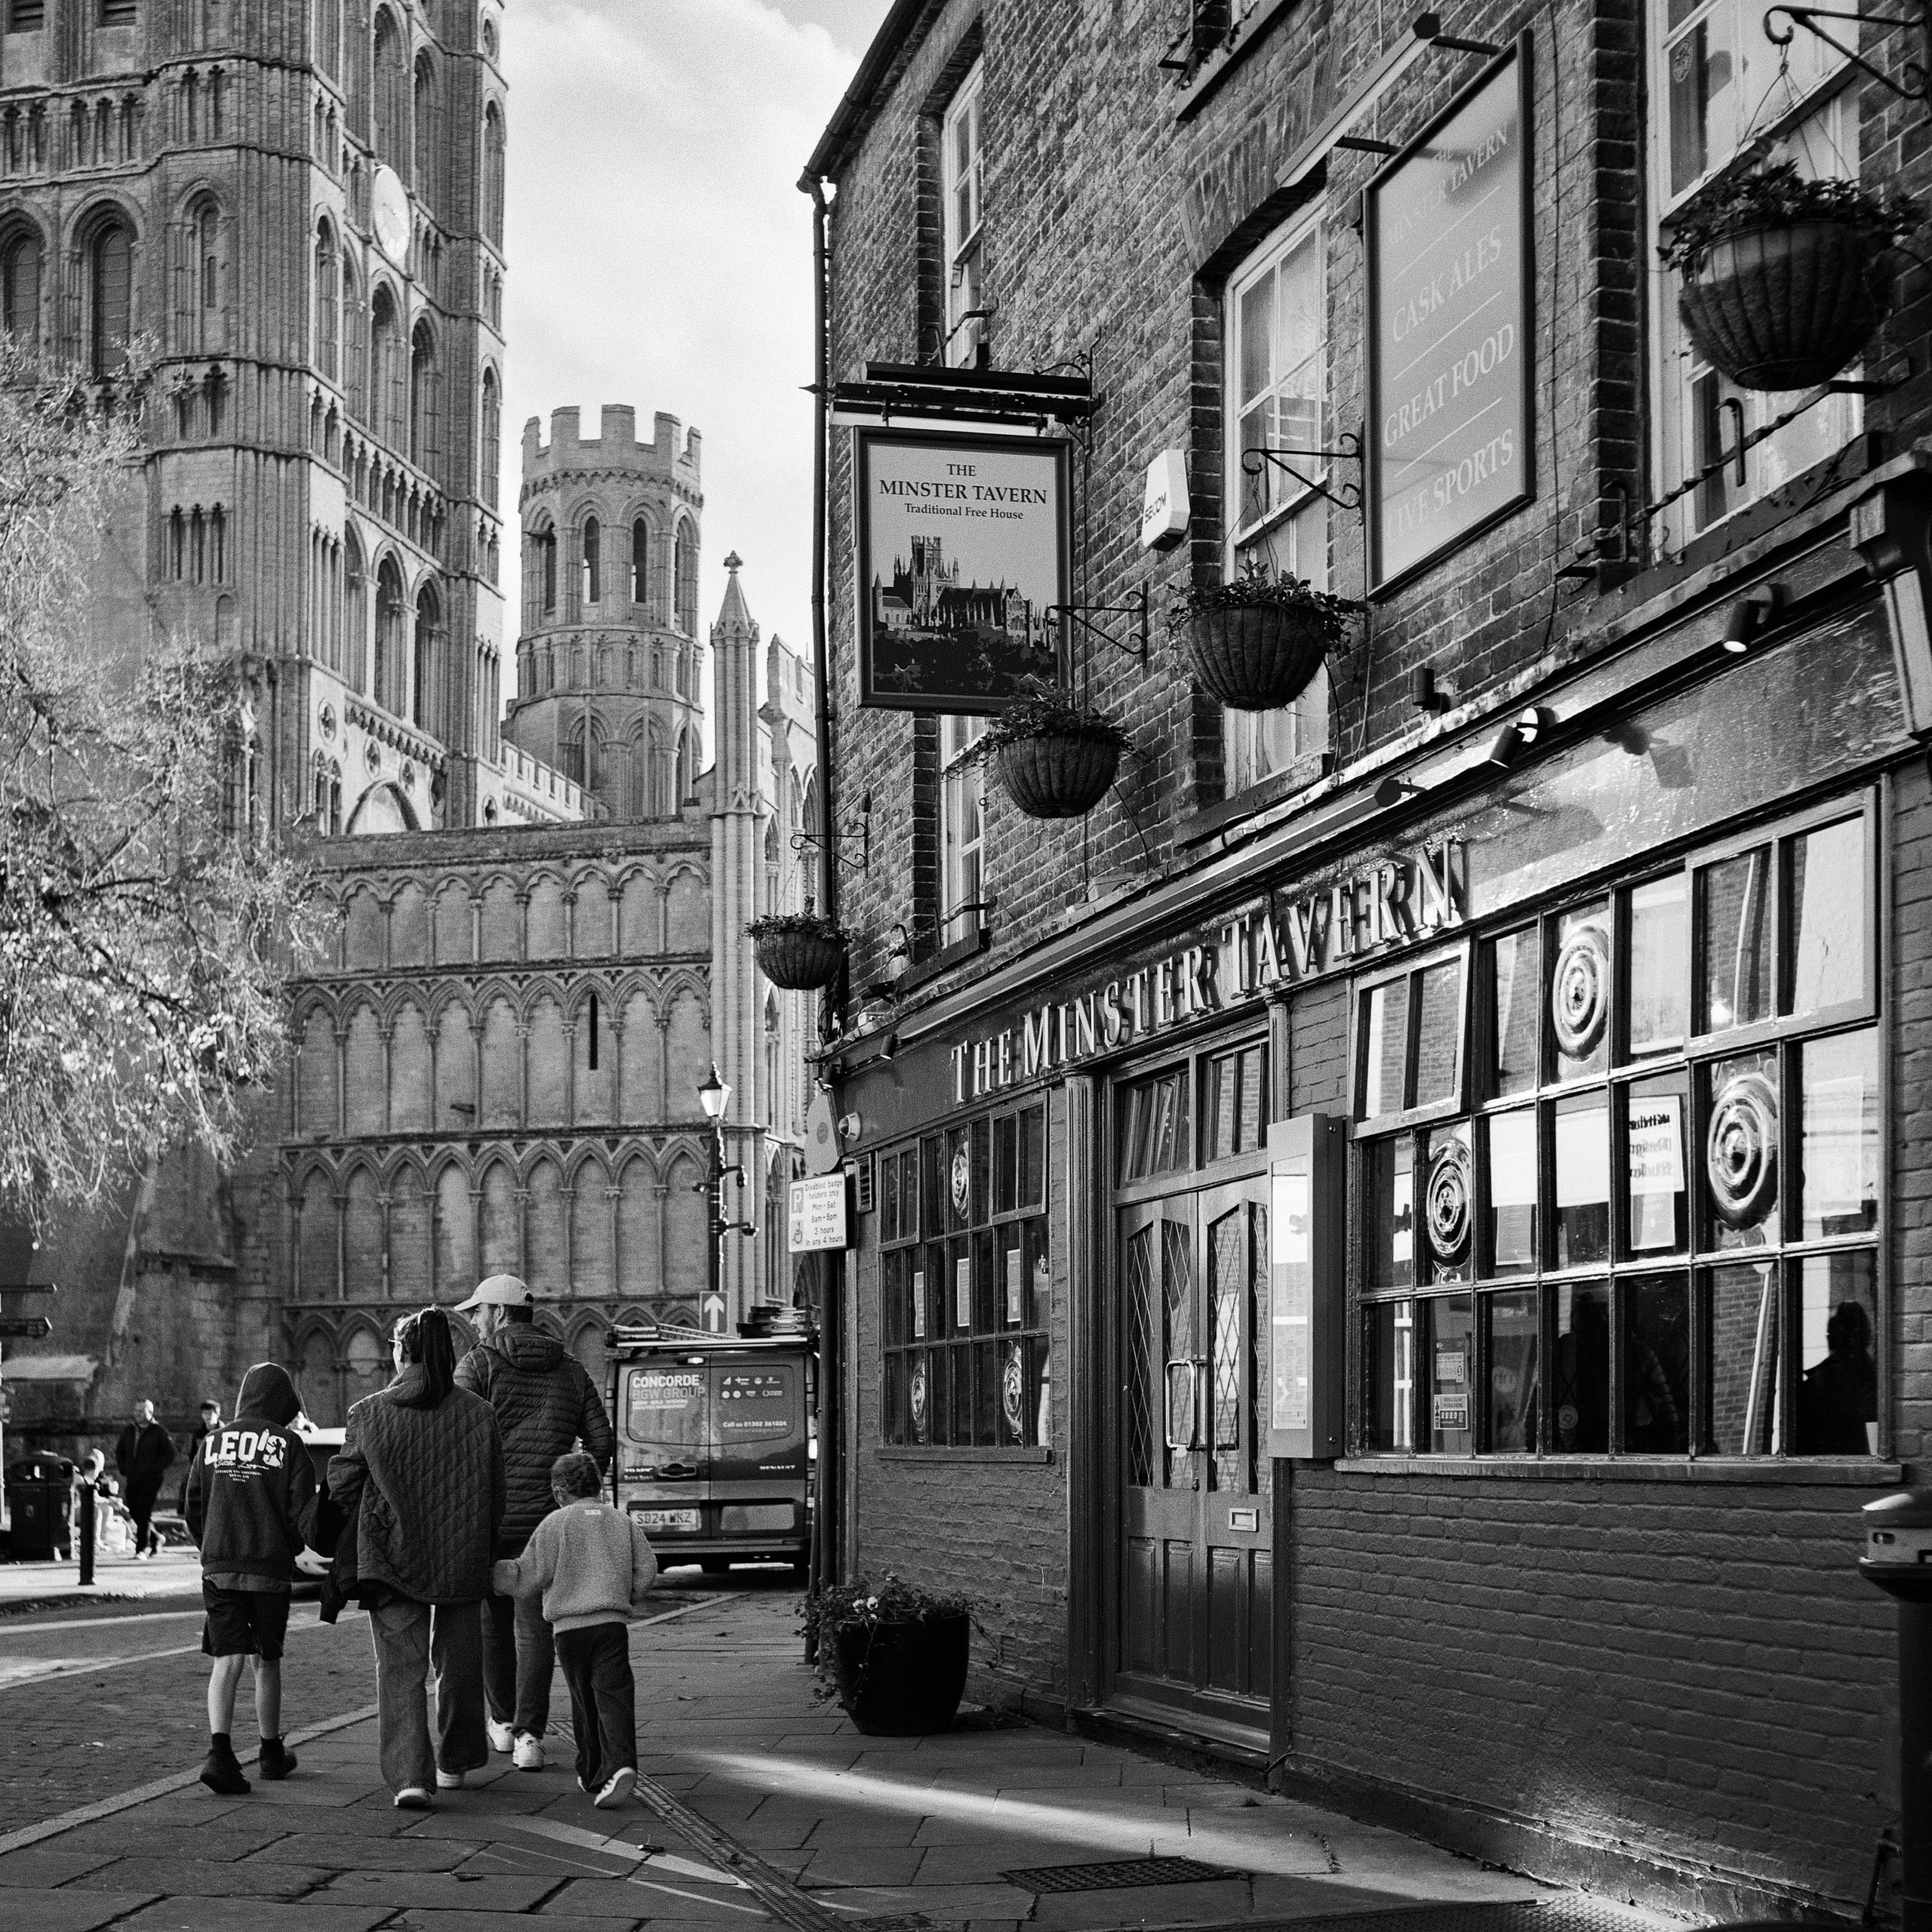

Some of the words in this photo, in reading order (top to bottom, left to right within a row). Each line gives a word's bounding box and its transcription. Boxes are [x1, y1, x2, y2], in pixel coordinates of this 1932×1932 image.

[1451, 123, 1507, 192] TAVERN
[1394, 272, 1446, 340] CASK
[1448, 226, 1502, 298] ALES
[1383, 373, 1447, 448] GREAT
[1451, 323, 1514, 398] FOOD
[946, 463, 977, 476] THE
[1433, 429, 1513, 512] SPORTS
[879, 479, 968, 500] MINSTER
[972, 485, 1048, 504] TAVERN
[904, 503, 962, 516] Traditional
[965, 506, 987, 518] Free
[989, 508, 1023, 520] House
[951, 1028, 1014, 1104] THE
[1023, 944, 1208, 1078] MINSTER
[1221, 838, 1463, 1000] TAVERN
[805, 1183, 826, 1192] Disabled
[827, 1180, 843, 1189] badge
[809, 1191, 827, 1200] holders
[812, 1203, 823, 1211] Mon
[826, 1201, 836, 1209] Sat
[820, 1226, 834, 1235] hours
[829, 1235, 844, 1244] hours
[632, 1374, 700, 1389] CONCORDE
[632, 1388, 661, 1400] BGW
[663, 1386, 706, 1398] GROUP
[204, 1429, 287, 1469] LEO'S
